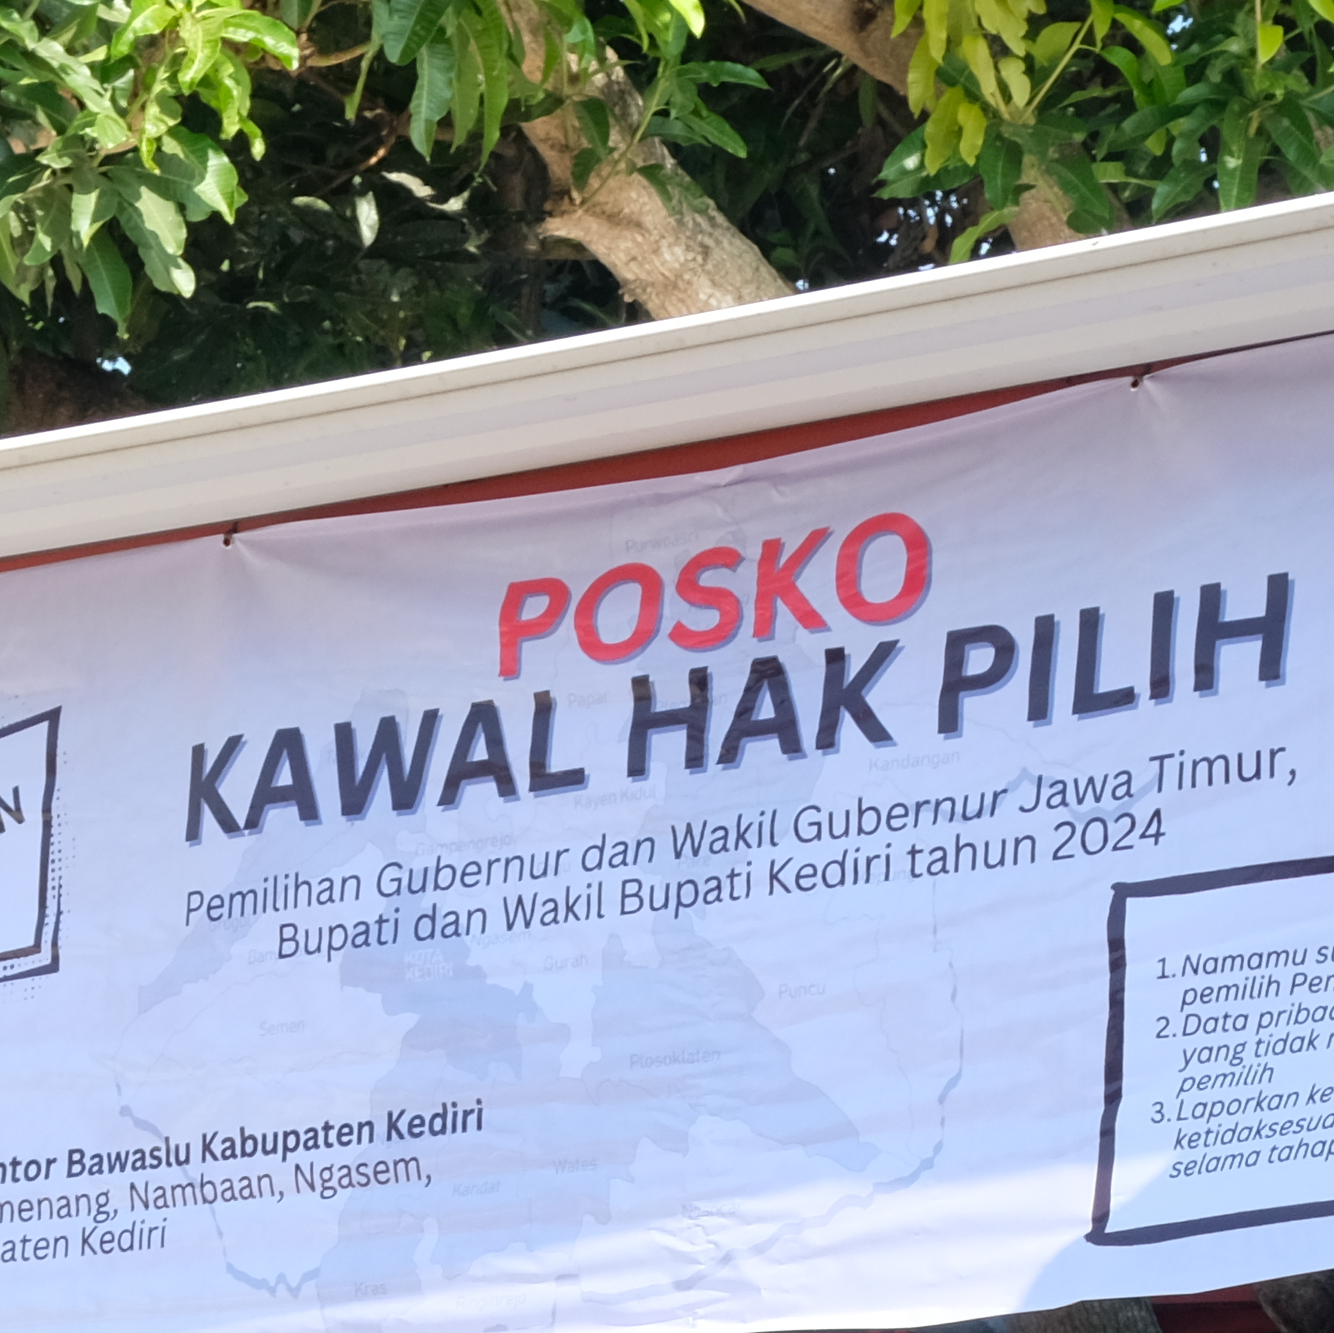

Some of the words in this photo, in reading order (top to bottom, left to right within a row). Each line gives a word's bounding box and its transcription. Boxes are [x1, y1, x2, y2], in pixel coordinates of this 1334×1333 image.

[497, 512, 931, 680] POSKO
[185, 690, 588, 843] KAWAL
[627, 638, 901, 779] HAK
[938, 572, 1291, 737] PILIH
[185, 869, 361, 927] Pemilihan
[376, 848, 570, 899] Gubernur
[581, 832, 656, 873] dan
[670, 810, 780, 863] Wakil
[793, 786, 1008, 844] Gubernur
[1019, 769, 1135, 814] Jawa
[1150, 745, 1298, 795] Timur,
[278, 907, 400, 962] Bupati
[413, 903, 488, 943] dan
[502, 881, 606, 932] Wakil
[620, 862, 754, 920] Bupati
[768, 841, 892, 897] Kediri
[905, 833, 1037, 880] tahun
[1052, 807, 1166, 863] 2024
[1156, 957, 1177, 980] 1.
[1180, 947, 1308, 978] Namamu
[1179, 975, 1282, 1012] pemilih
[1155, 1016, 1178, 1039] 2.
[1182, 1011, 1249, 1037] Data
[1178, 1041, 1248, 1073] yang
[1253, 1028, 1319, 1059] tidak
[1176, 1062, 1275, 1100] pemilih
[1150, 1101, 1172, 1124] 3.
[1175, 1087, 1301, 1125] Laporkan
[1305, 1082, 1334, 1106] ke
[66, 1137, 192, 1180] Bawaslu
[200, 1117, 375, 1168] Kabupaten
[385, 1097, 485, 1143] Kediri
[129, 1169, 285, 1212] Nambaan,
[293, 1156, 433, 1200] Ngasem,
[1168, 1148, 1260, 1179] selama
[80, 1219, 167, 1257] Kediri
